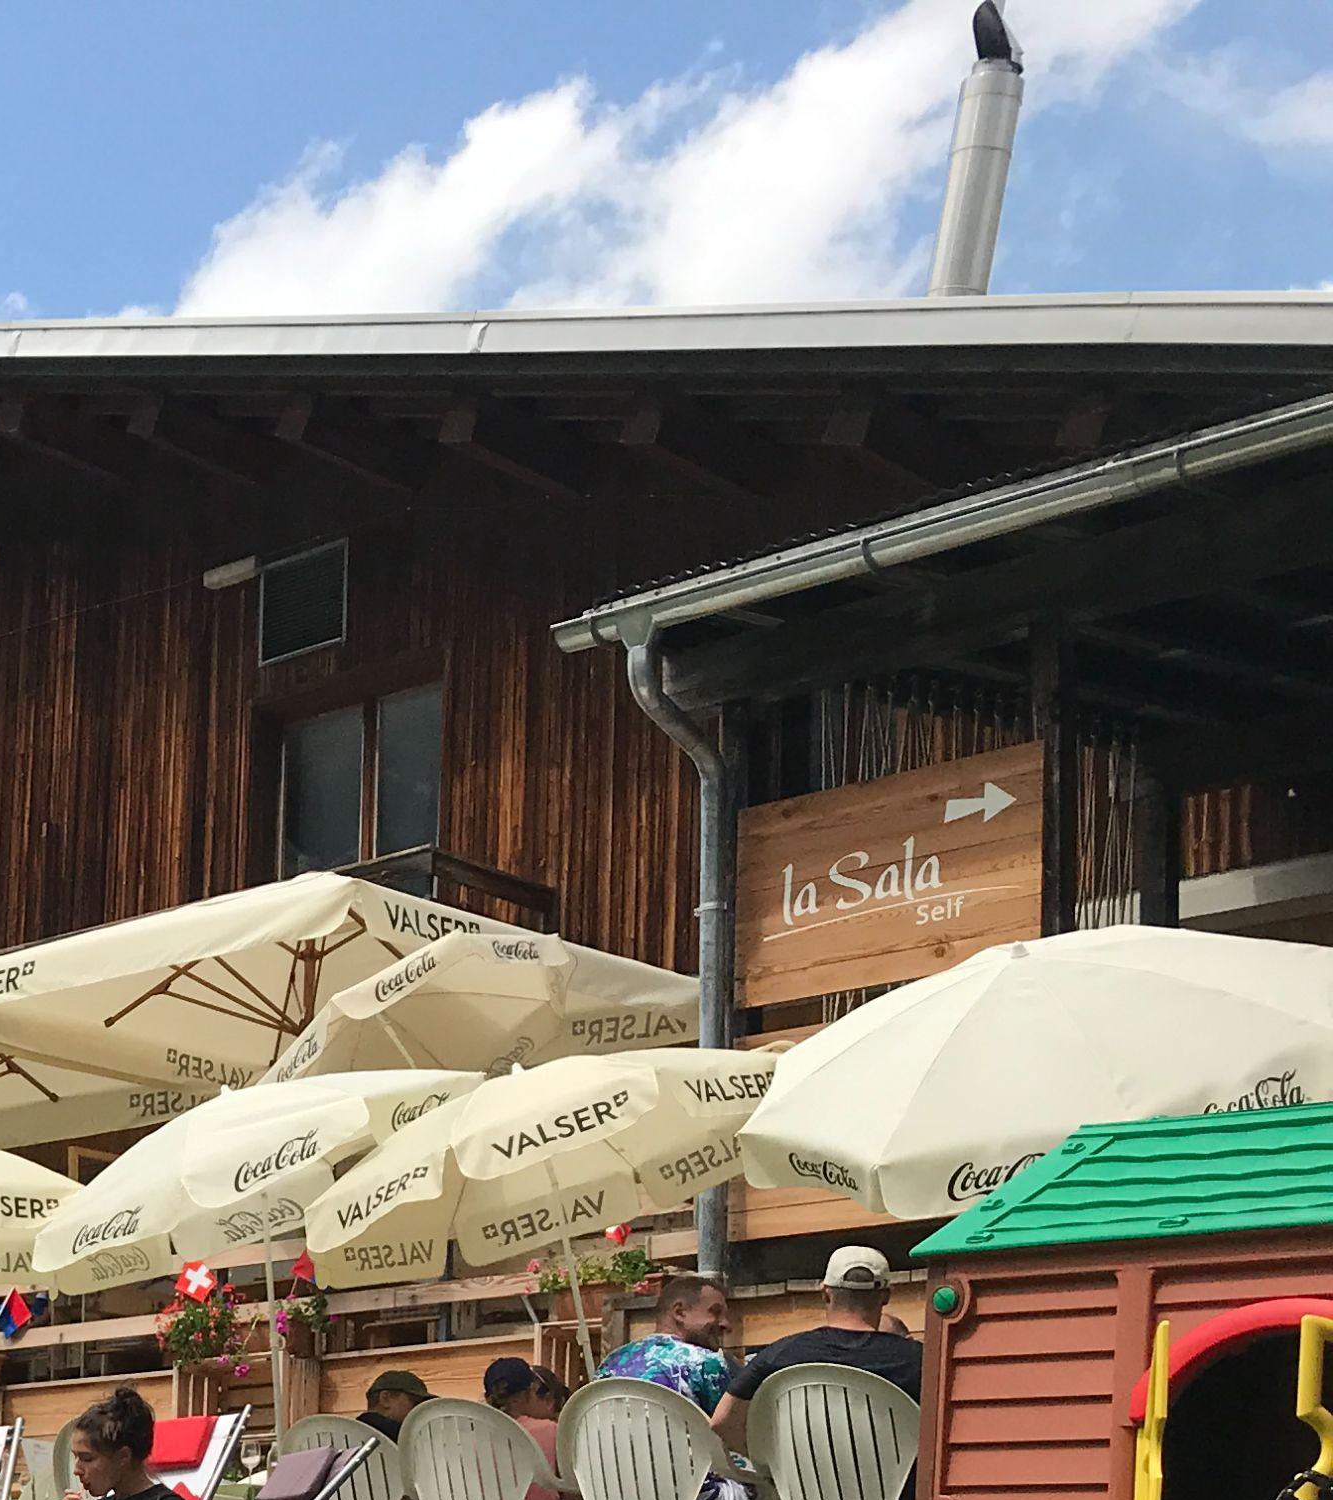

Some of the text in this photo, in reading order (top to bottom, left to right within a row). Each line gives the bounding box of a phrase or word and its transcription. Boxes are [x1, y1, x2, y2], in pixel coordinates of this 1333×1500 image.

[829, 835, 944, 911] Sala
[915, 895, 965, 926] Self
[374, 951, 437, 1002] Coca-Cola
[491, 1100, 619, 1160] VALSER
[234, 1127, 320, 1193] Coca-Cola
[788, 1152, 859, 1191] Coca-Cola
[336, 1172, 411, 1230] VALSER
[72, 1203, 145, 1255] Coca-Cola
